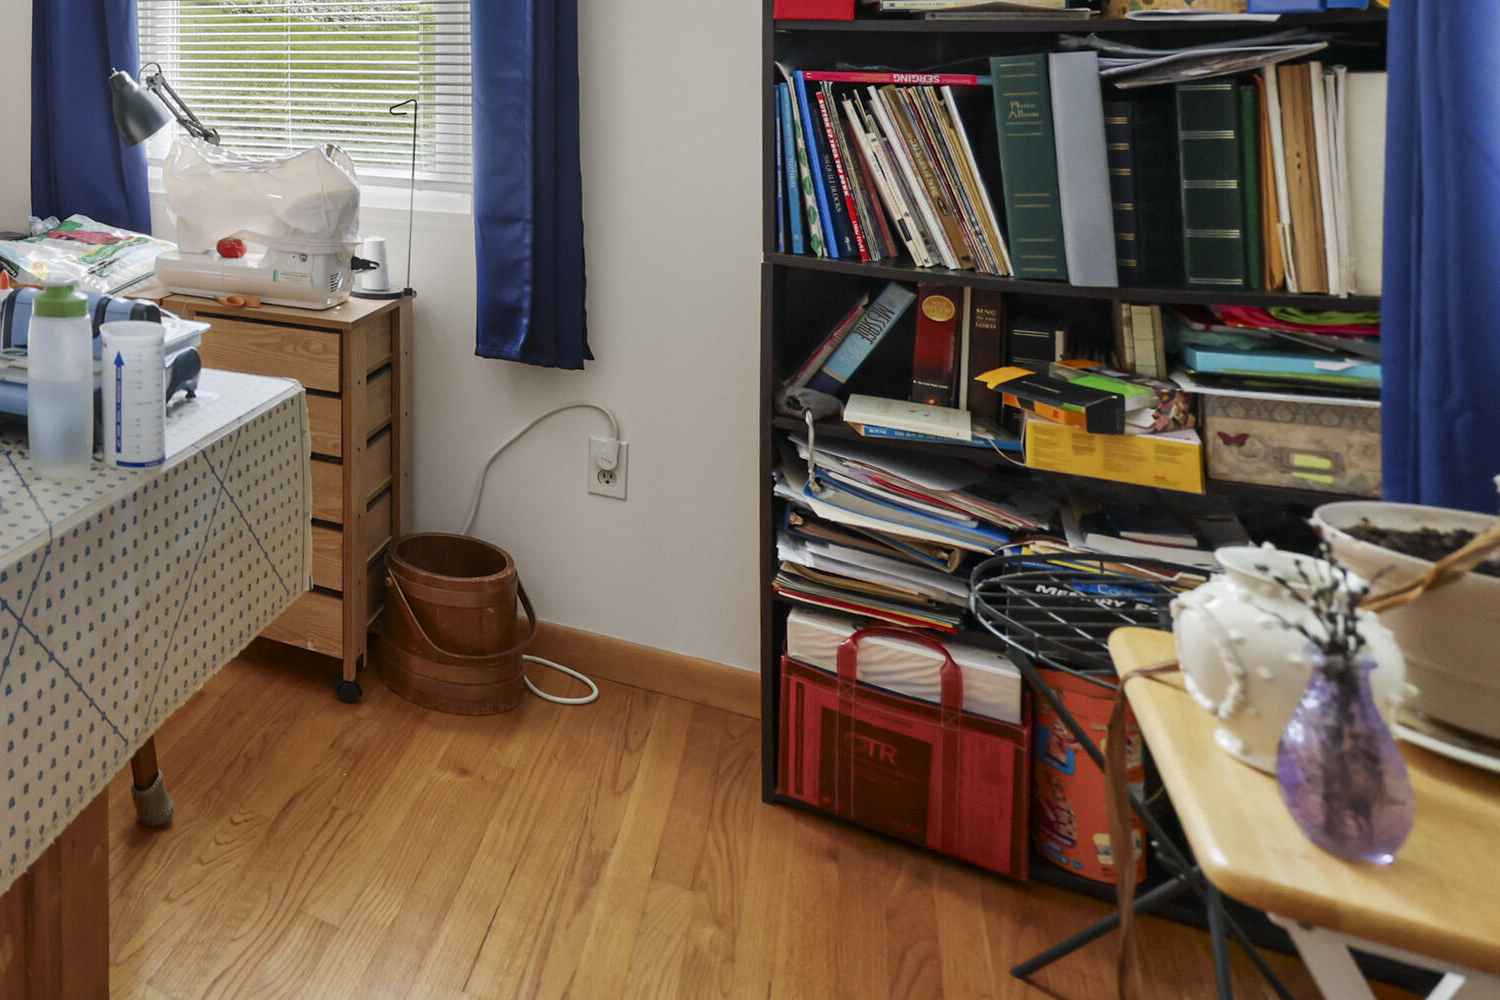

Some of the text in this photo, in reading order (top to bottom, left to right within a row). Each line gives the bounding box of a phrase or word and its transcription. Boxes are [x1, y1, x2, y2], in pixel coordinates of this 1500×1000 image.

[892, 73, 940, 83] SERGING
[819, 99, 830, 127] BUTTON
[853, 302, 896, 344] MESSAGE
[1035, 584, 1126, 608] MEMRY
